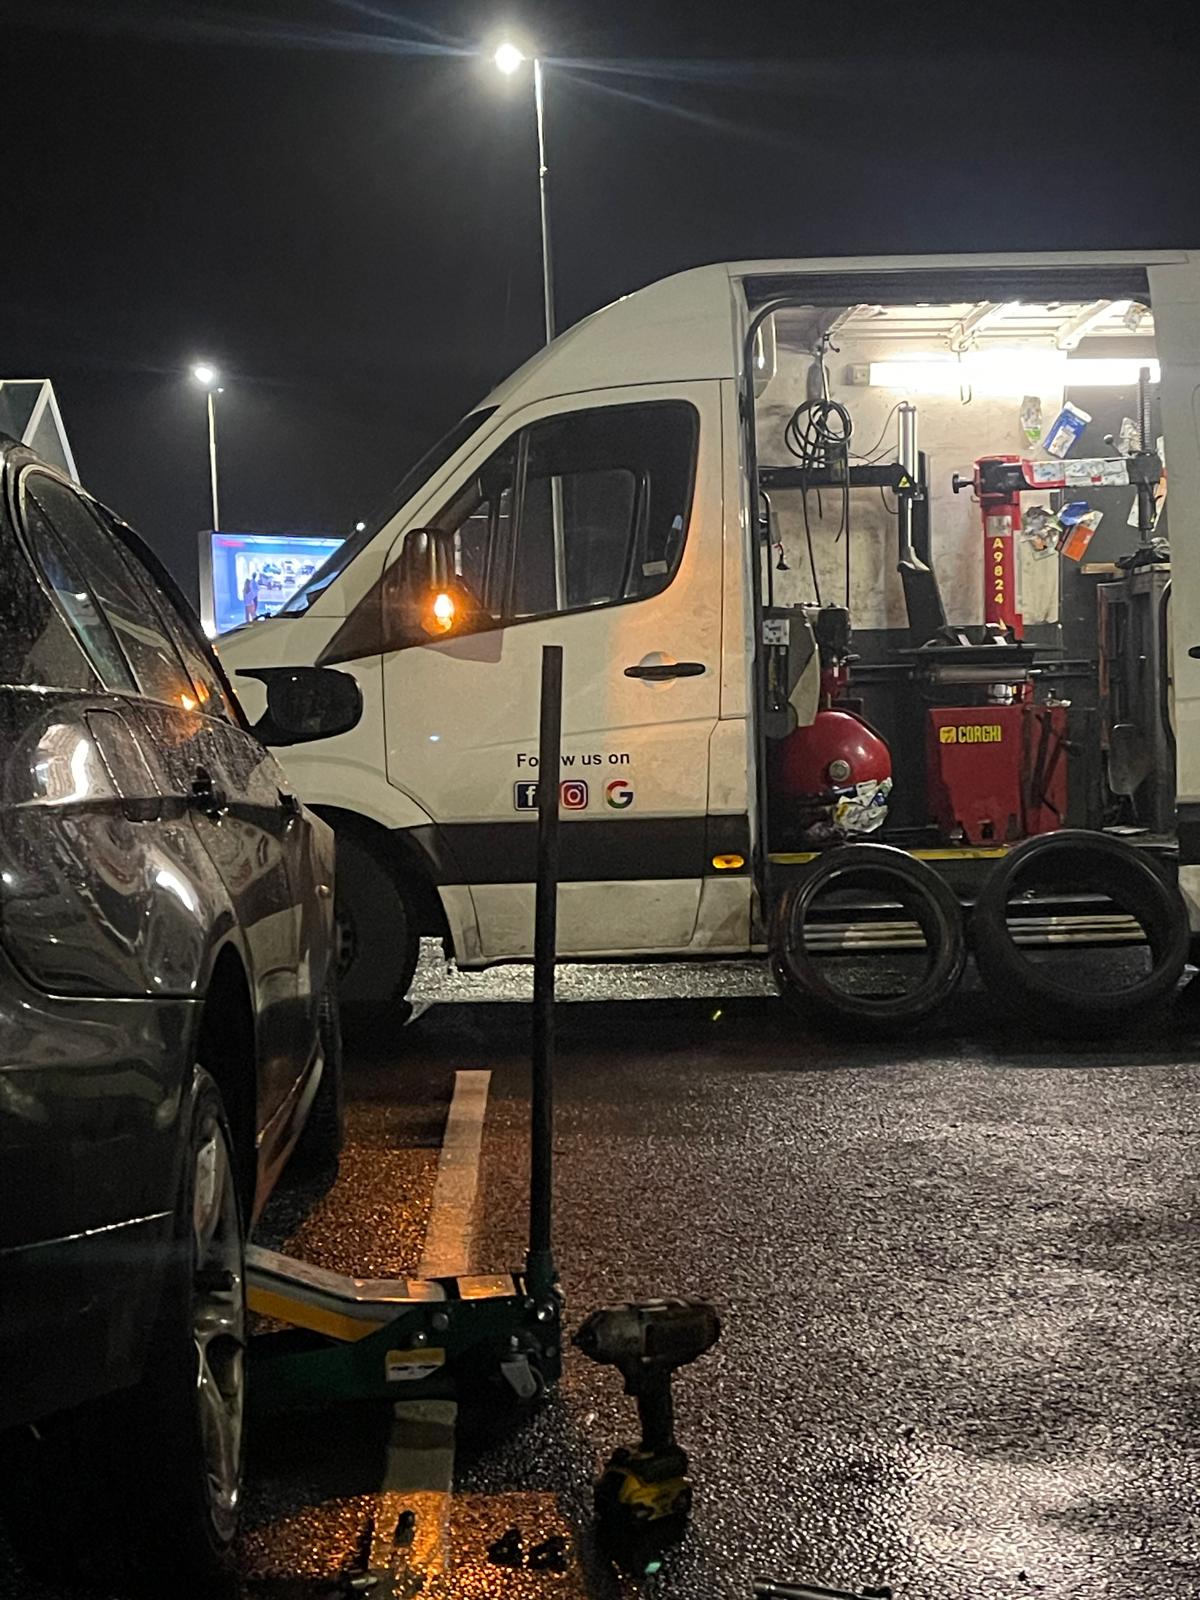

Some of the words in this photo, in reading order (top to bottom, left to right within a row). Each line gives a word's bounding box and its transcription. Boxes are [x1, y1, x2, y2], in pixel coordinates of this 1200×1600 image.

[992, 537, 1004, 604] A9824
[958, 725, 1002, 743] CORGHI
[517, 753, 575, 768] Fow
[581, 754, 602, 766] us
[608, 753, 630, 765] on
